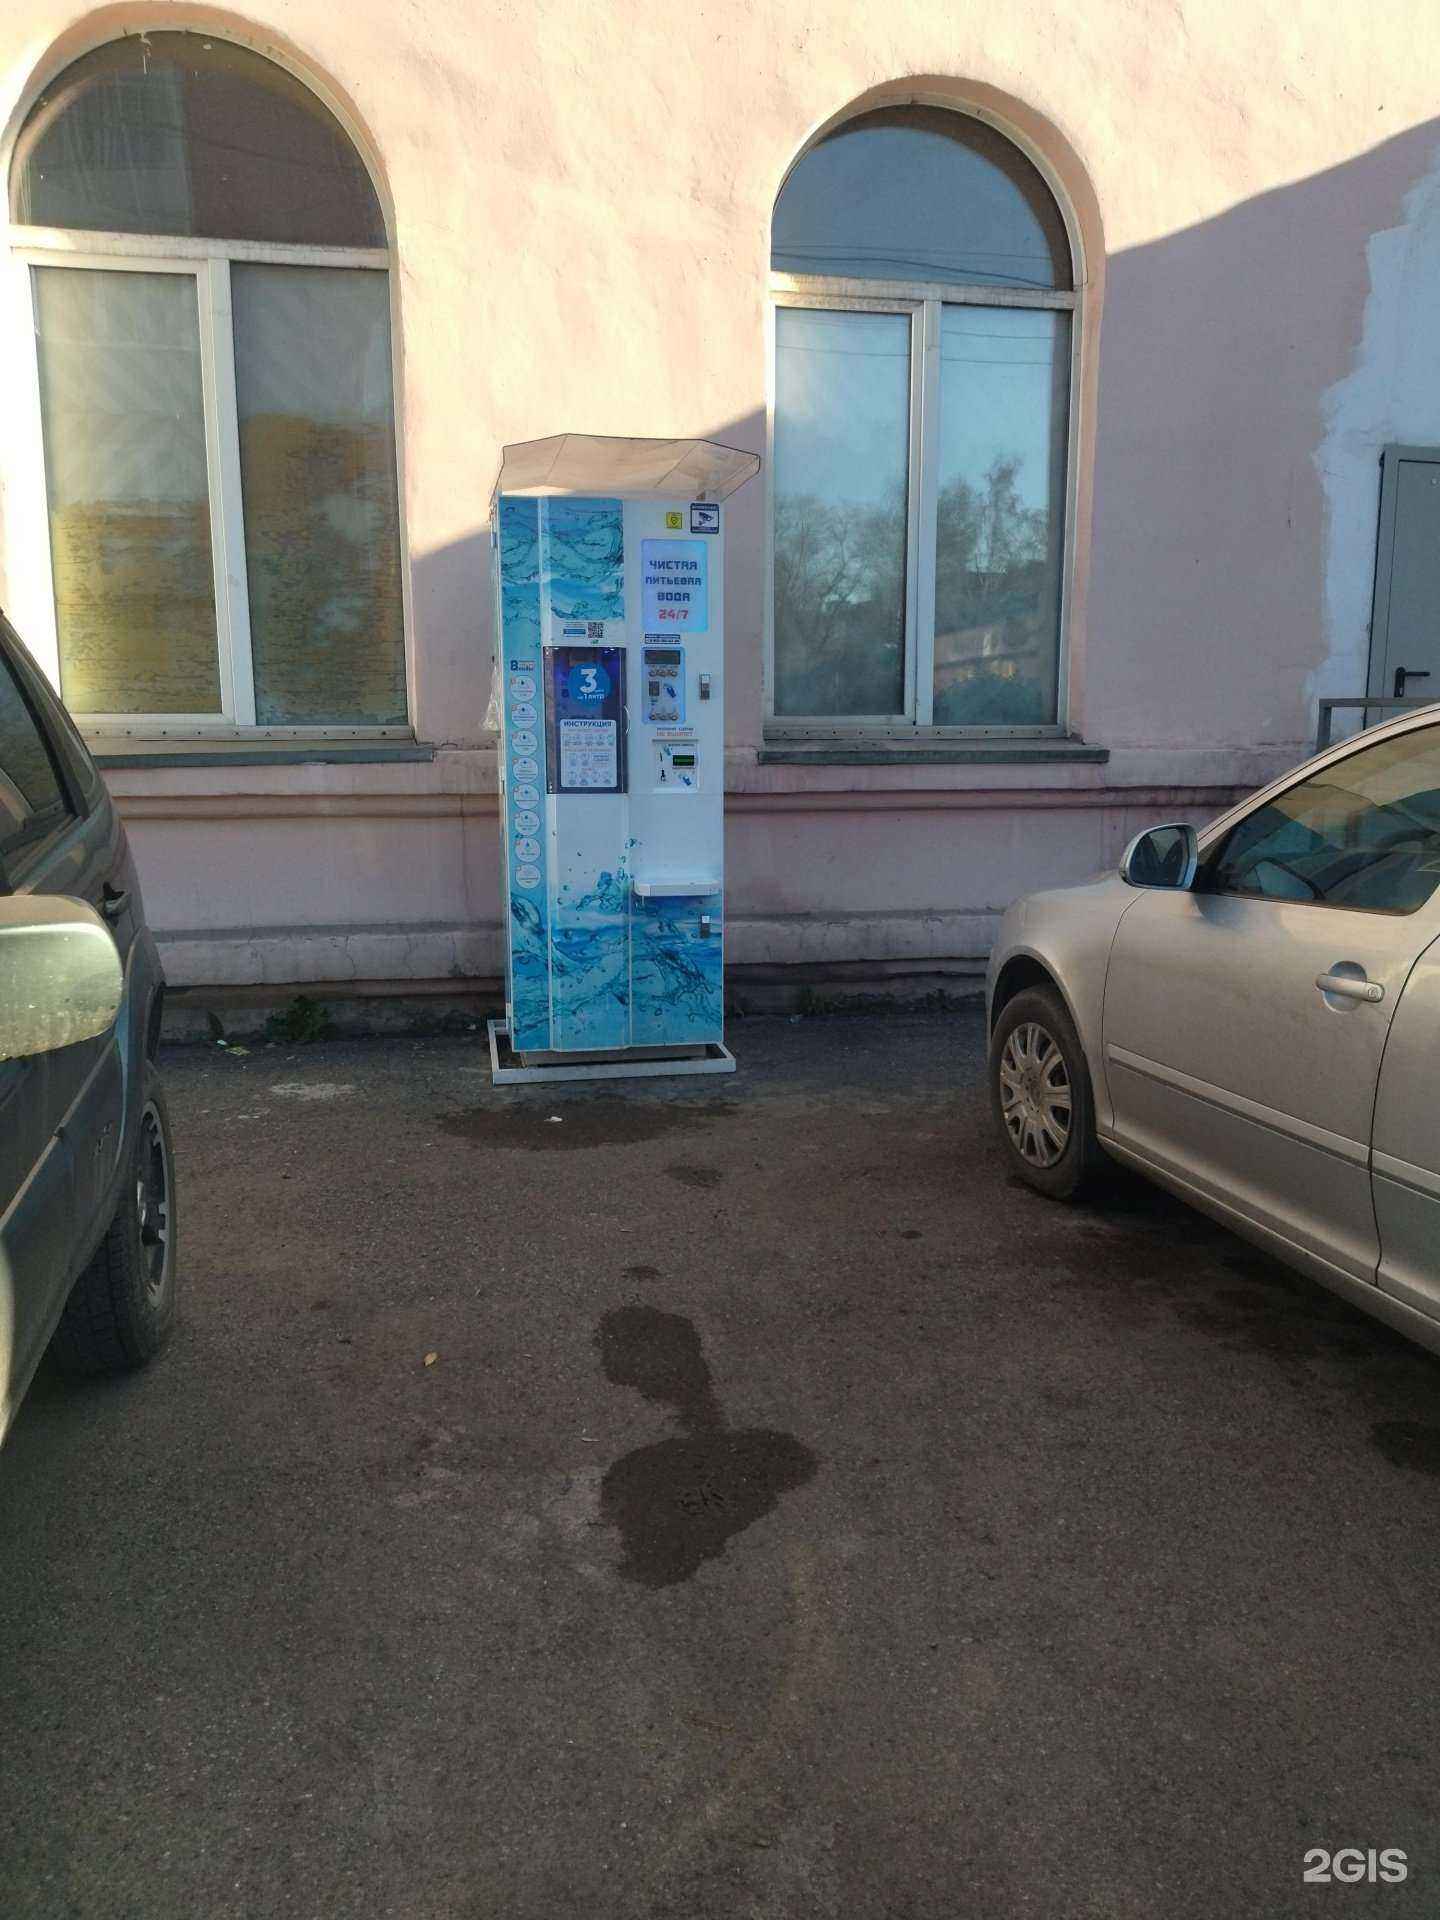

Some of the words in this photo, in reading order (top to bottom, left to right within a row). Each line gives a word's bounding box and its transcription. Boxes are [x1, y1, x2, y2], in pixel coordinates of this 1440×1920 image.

[649, 560, 698, 570] ЧИСТАЯ
[645, 576, 702, 585] ПИТЬЕВАЯ
[657, 592, 691, 602] ВОДА
[658, 608, 689, 620] 24/7
[580, 668, 597, 693] 3
